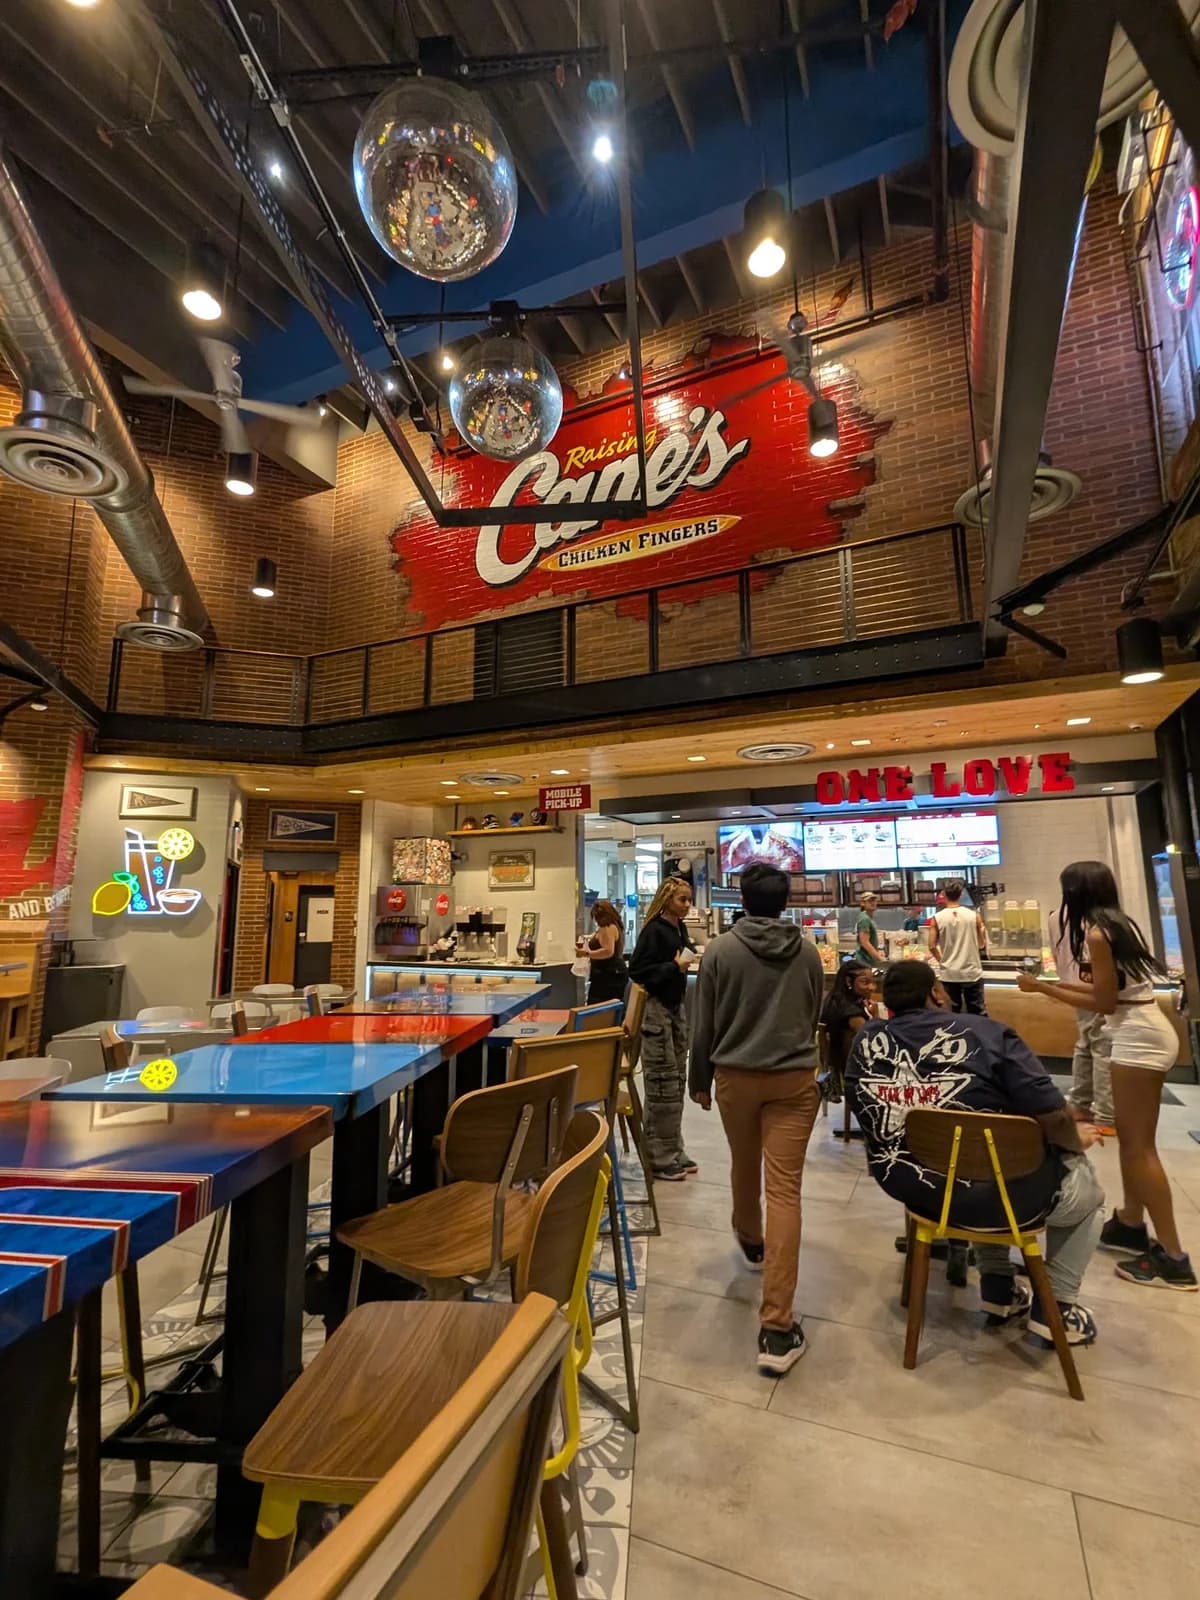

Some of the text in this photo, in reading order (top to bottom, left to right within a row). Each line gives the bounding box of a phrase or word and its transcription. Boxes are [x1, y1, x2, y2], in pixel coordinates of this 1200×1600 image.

[563, 429, 657, 474] Raising
[475, 406, 750, 587] Cane's
[558, 519, 720, 568] CHICKEN FINGERS
[545, 787, 582, 800] MOBILE
[817, 752, 1076, 805] ONE LOVE
[545, 798, 583, 810] PICK-UP
[9, 899, 41, 920] AND
